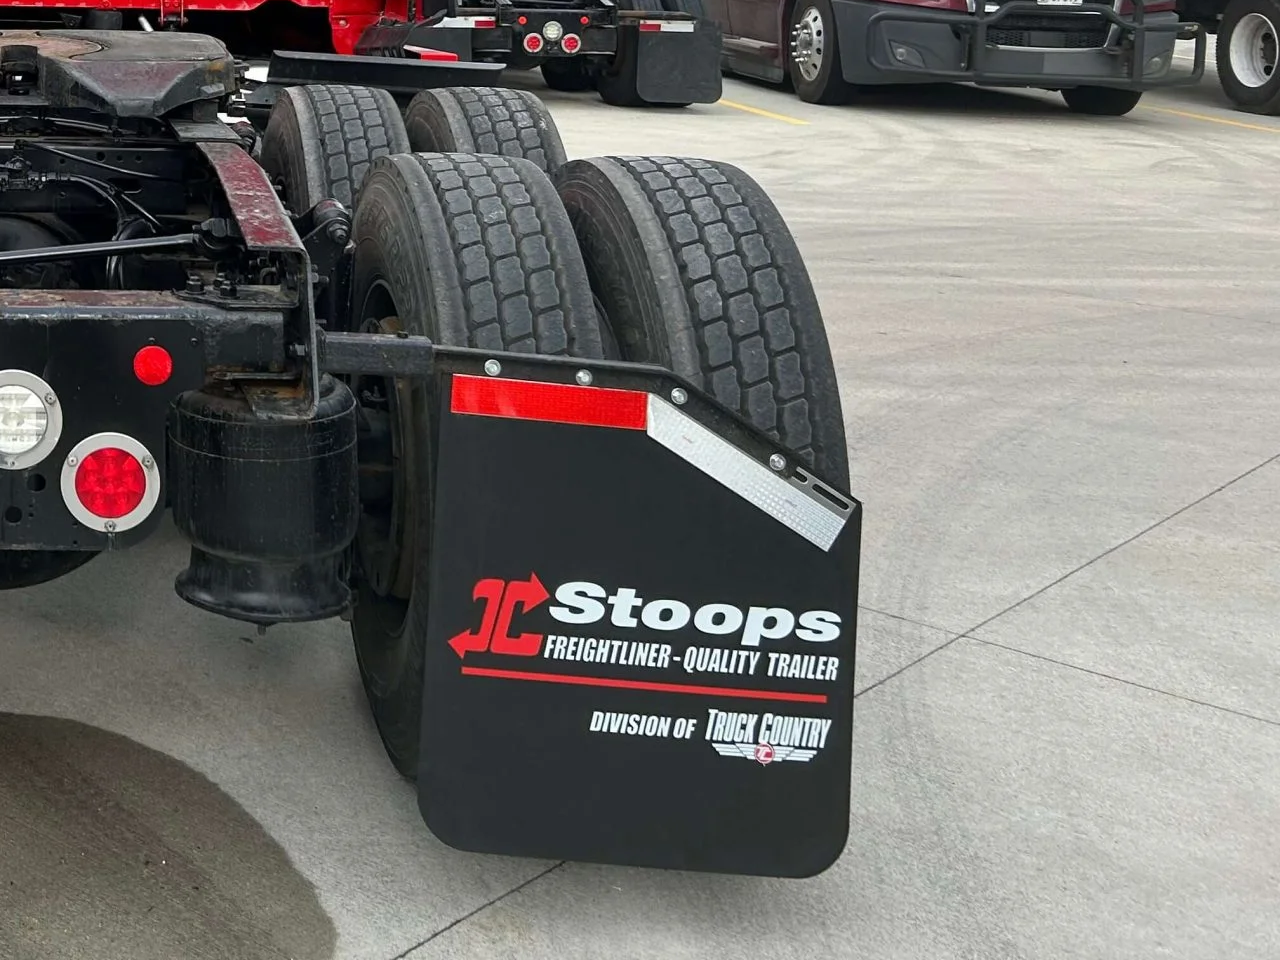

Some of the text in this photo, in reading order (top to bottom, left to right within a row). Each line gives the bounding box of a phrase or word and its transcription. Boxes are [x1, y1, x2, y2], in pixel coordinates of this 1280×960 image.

[548, 581, 842, 647] Stoops
[543, 634, 672, 668] FREIGHTLINER
[682, 646, 760, 675] QUALITY
[767, 652, 839, 681] TRAILER
[589, 709, 832, 749] DIVISION OF TRUCK COUNTRY
